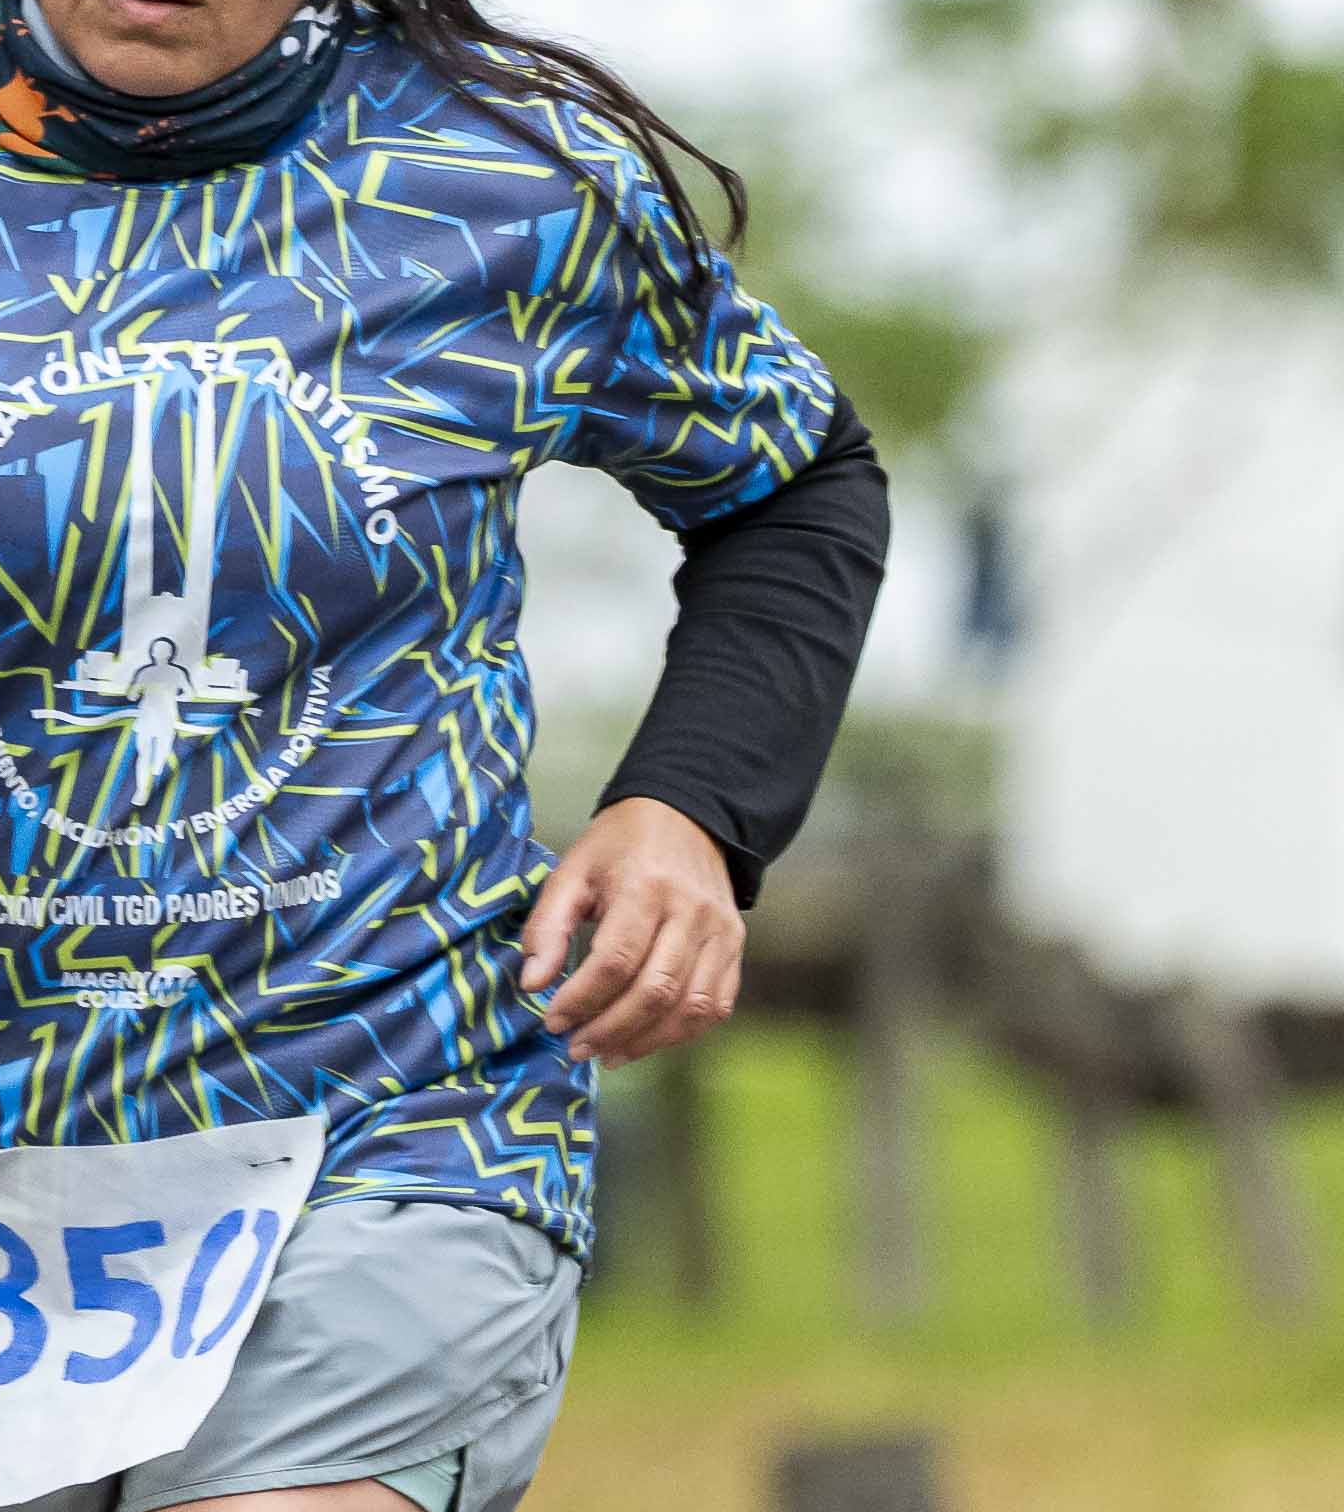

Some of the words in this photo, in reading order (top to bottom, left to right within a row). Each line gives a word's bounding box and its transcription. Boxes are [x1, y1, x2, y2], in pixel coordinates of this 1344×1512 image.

[143, 342, 177, 371] X
[192, 342, 239, 374] EL
[254, 359, 399, 546] AUTISMO
[168, 819, 186, 840] Y
[48, 895, 110, 926] CIVIL
[112, 894, 160, 926] TGD
[166, 885, 259, 923] PADRES
[262, 869, 342, 911] UNIDOS
